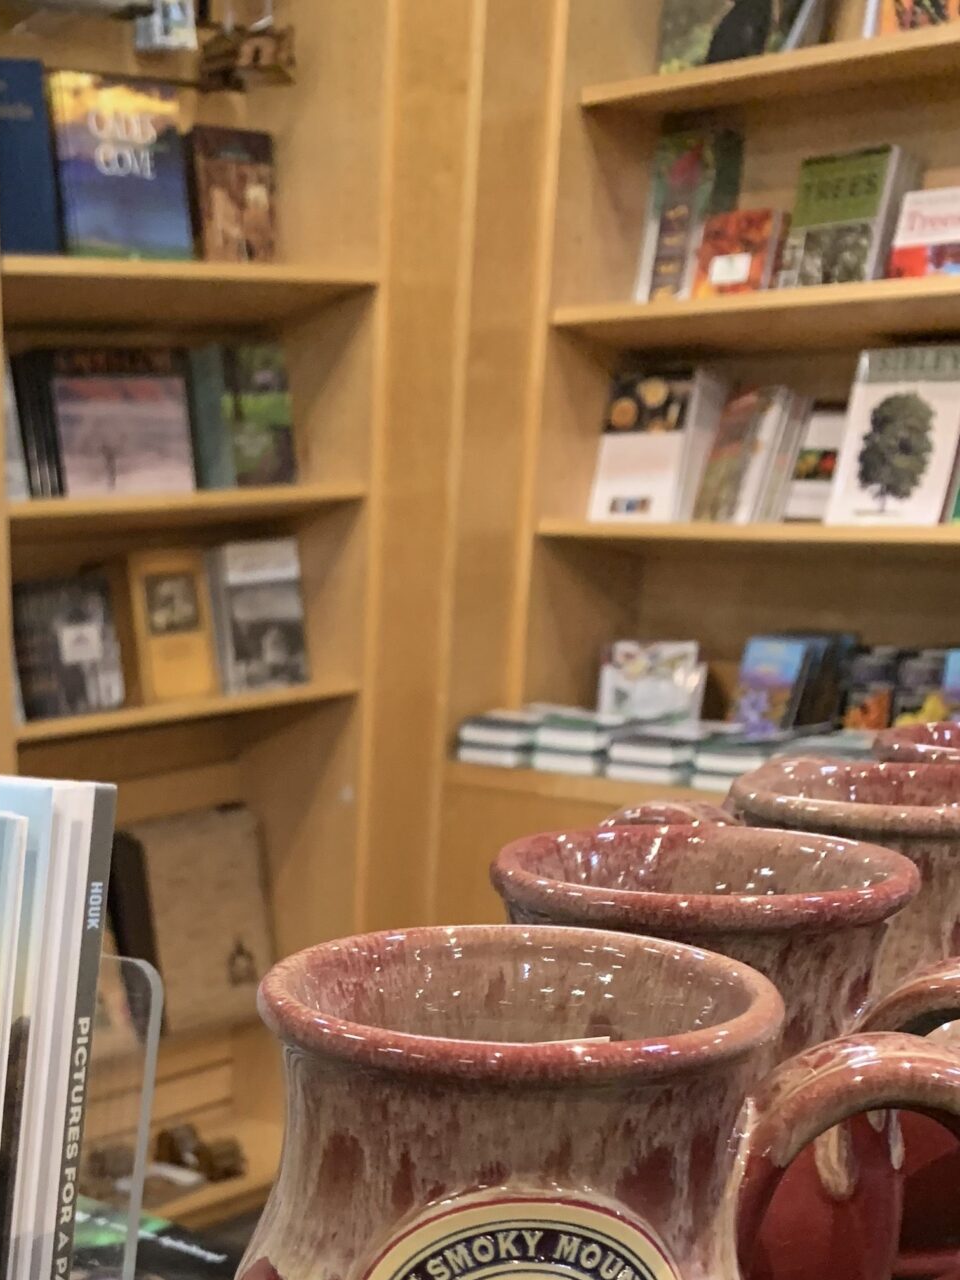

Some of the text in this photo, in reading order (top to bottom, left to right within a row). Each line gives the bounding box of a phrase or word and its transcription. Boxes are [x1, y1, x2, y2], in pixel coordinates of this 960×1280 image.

[86, 881, 104, 931] HOUK
[65, 1016, 91, 1161] PICTURES
[60, 1166, 78, 1226] FOR
[56, 1231, 71, 1252] A
